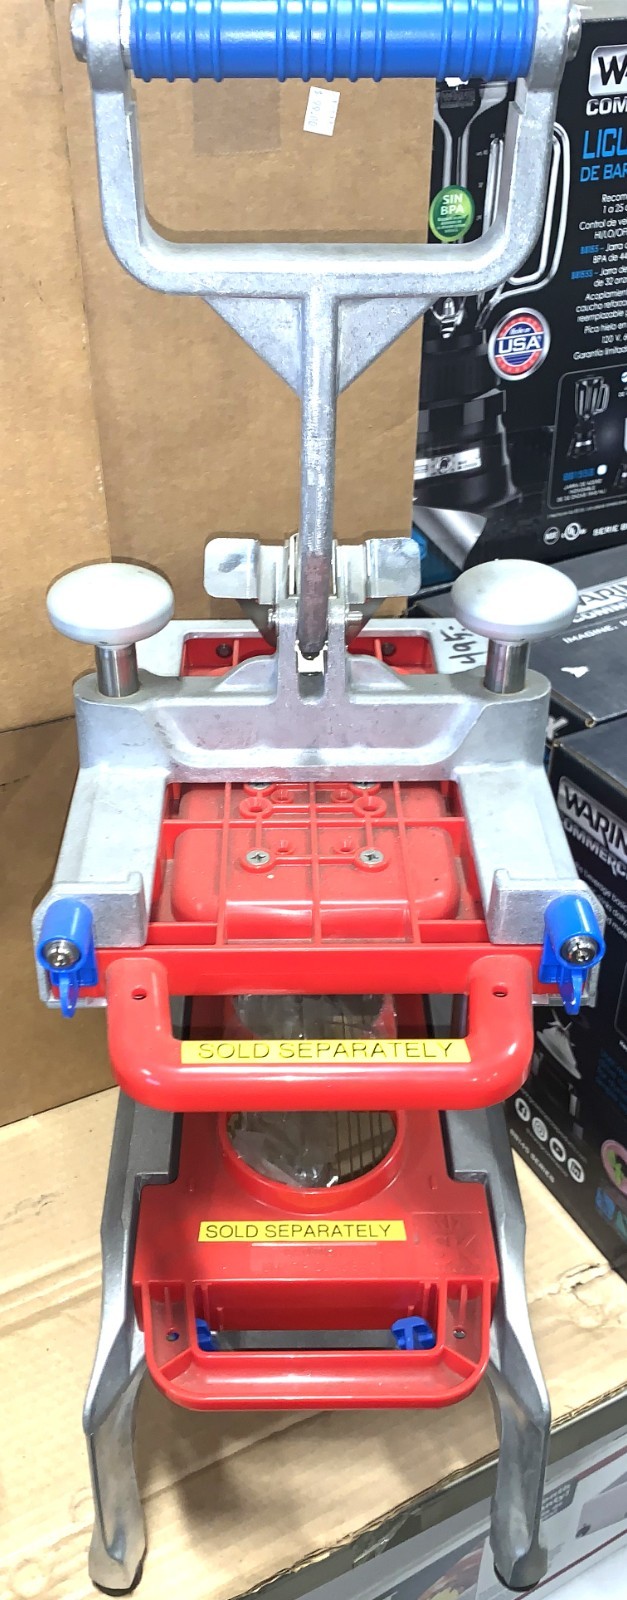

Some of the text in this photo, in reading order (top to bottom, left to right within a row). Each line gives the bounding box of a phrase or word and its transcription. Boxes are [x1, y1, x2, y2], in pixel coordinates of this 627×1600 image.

[580, 165, 600, 182] DE
[442, 193, 463, 205] SIN
[440, 203, 465, 216] BPA
[579, 219, 606, 231] Control
[606, 218, 617, 227] de
[498, 335, 541, 354] USA
[198, 1041, 454, 1060] SOLD SEPARATELY
[205, 1223, 392, 1239] SOLD SEPARATELY
